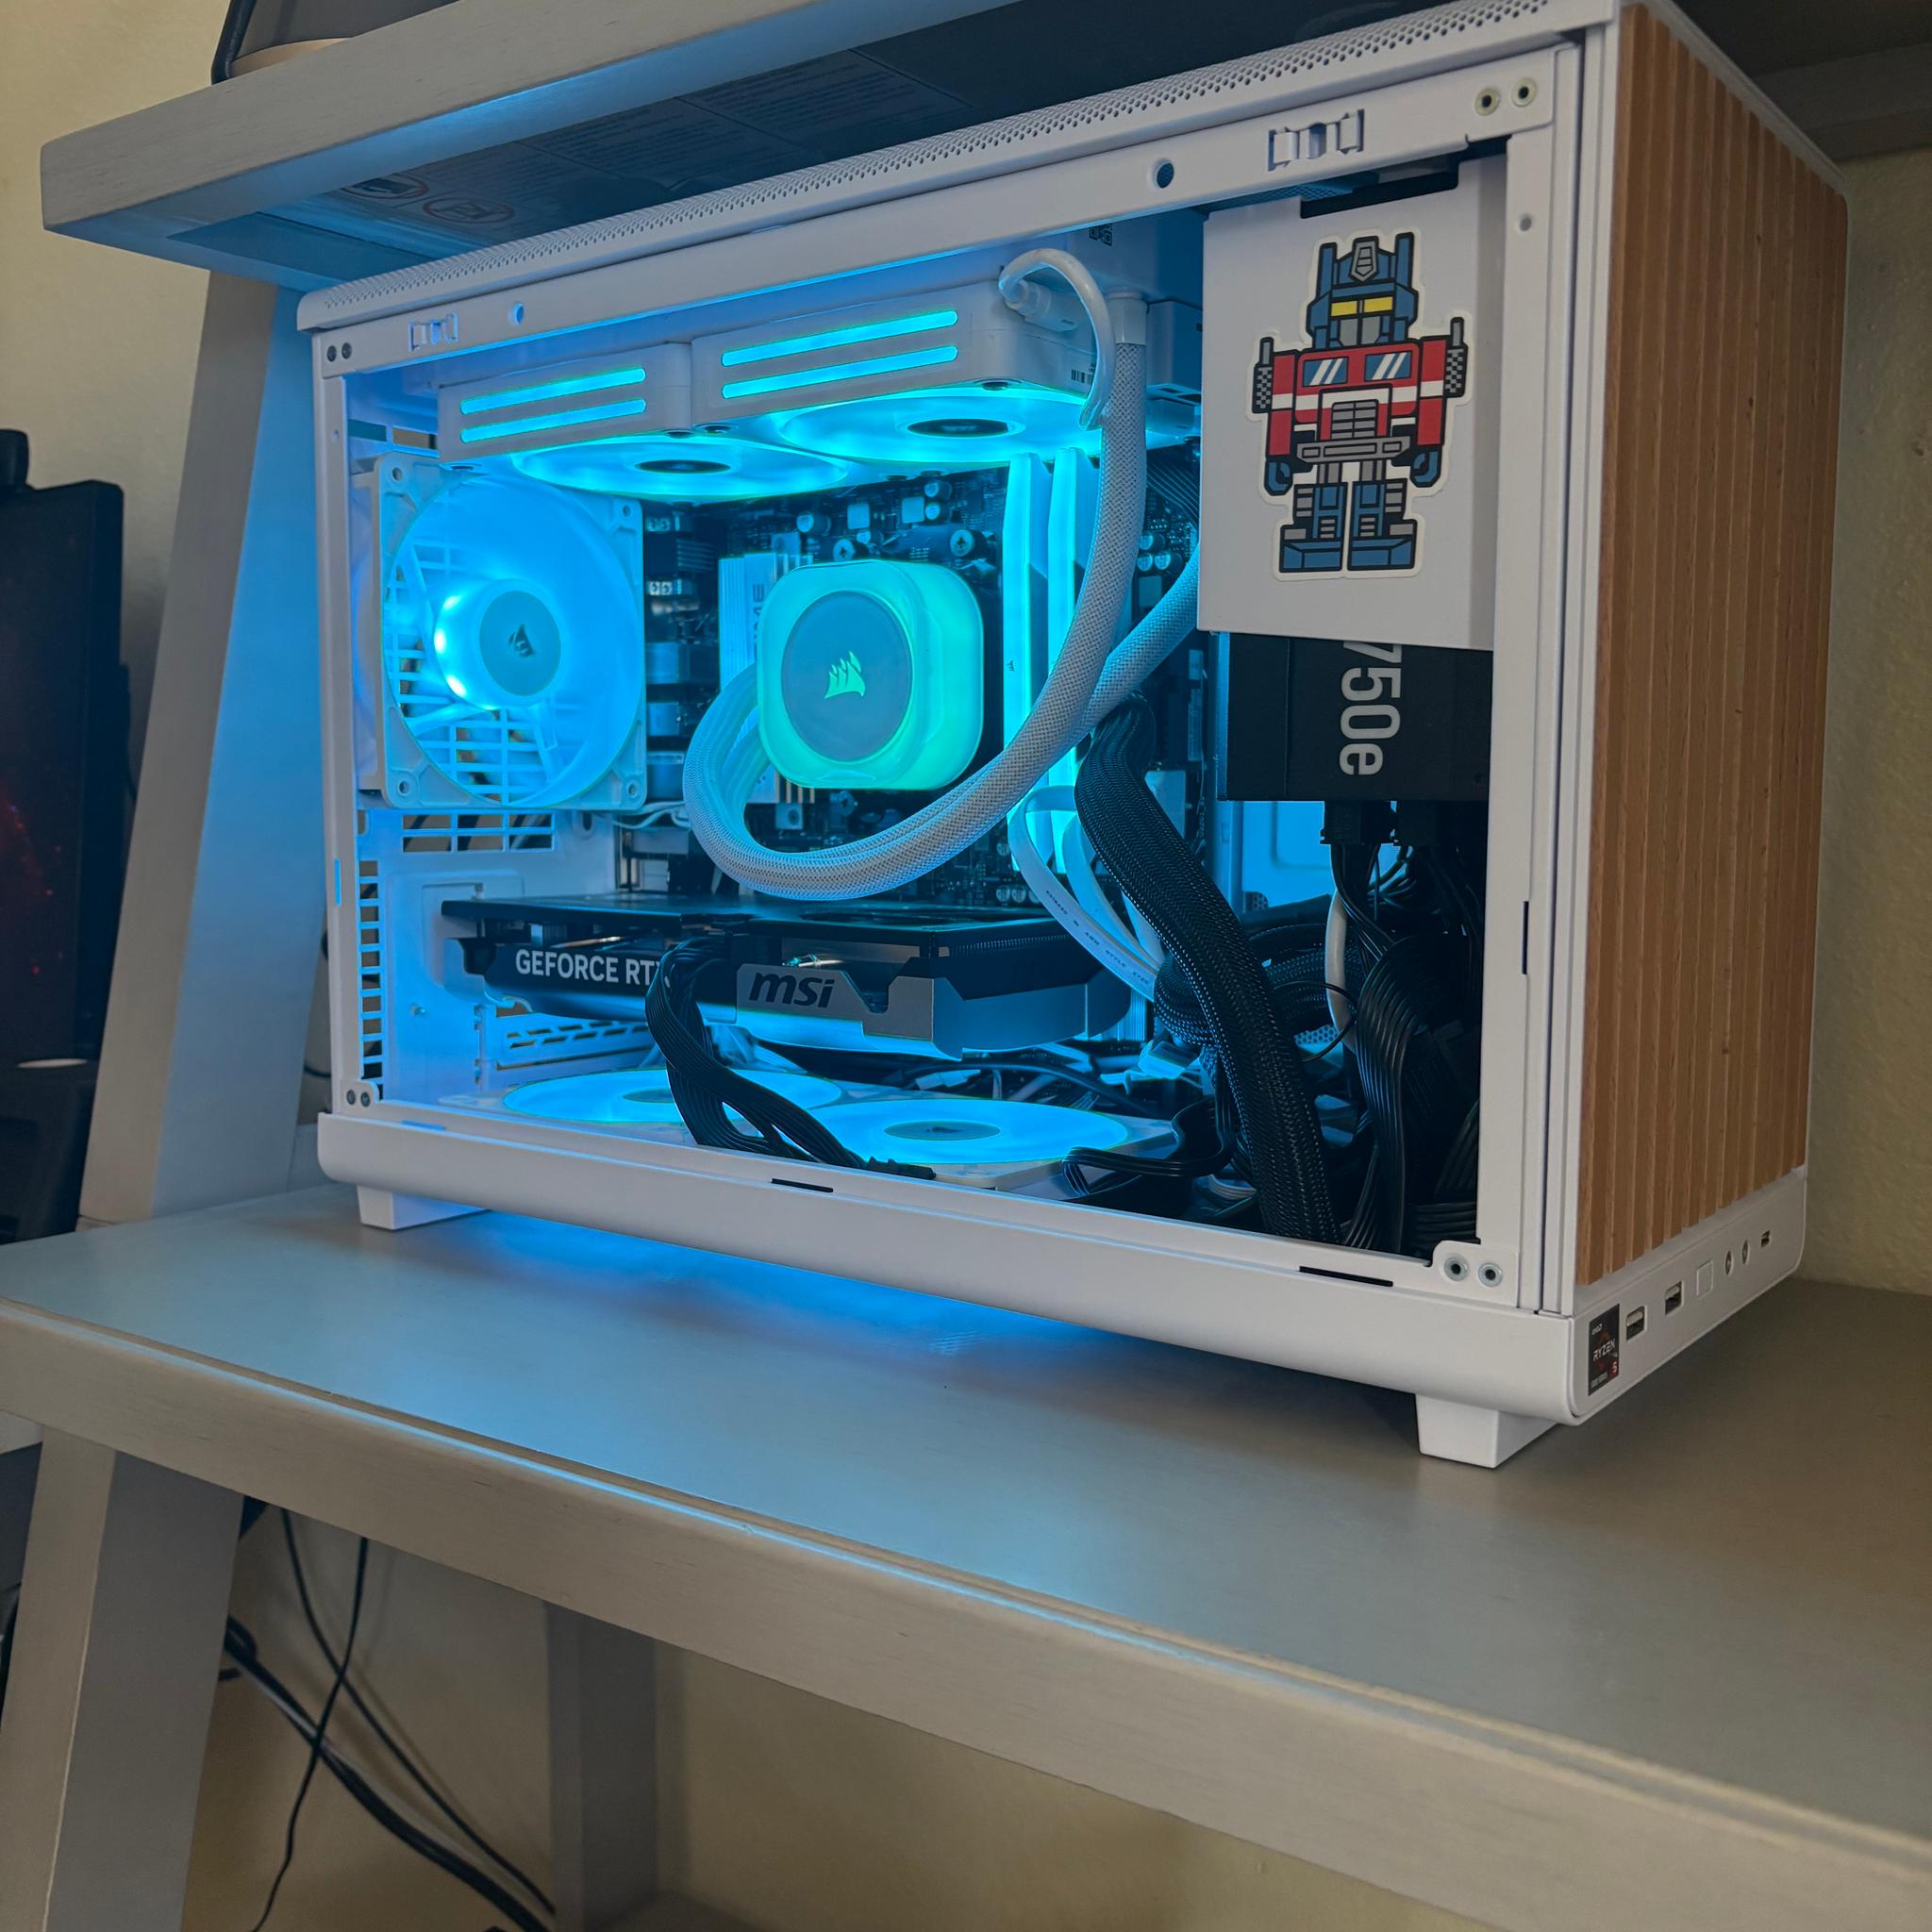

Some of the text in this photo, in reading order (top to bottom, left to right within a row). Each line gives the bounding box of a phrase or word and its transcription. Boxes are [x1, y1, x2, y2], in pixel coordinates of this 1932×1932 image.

[1339, 641, 1403, 775] 750e
[515, 948, 618, 983] GEFORCE
[749, 974, 834, 1008] msi
[1592, 1339, 1615, 1361] RYZEN
